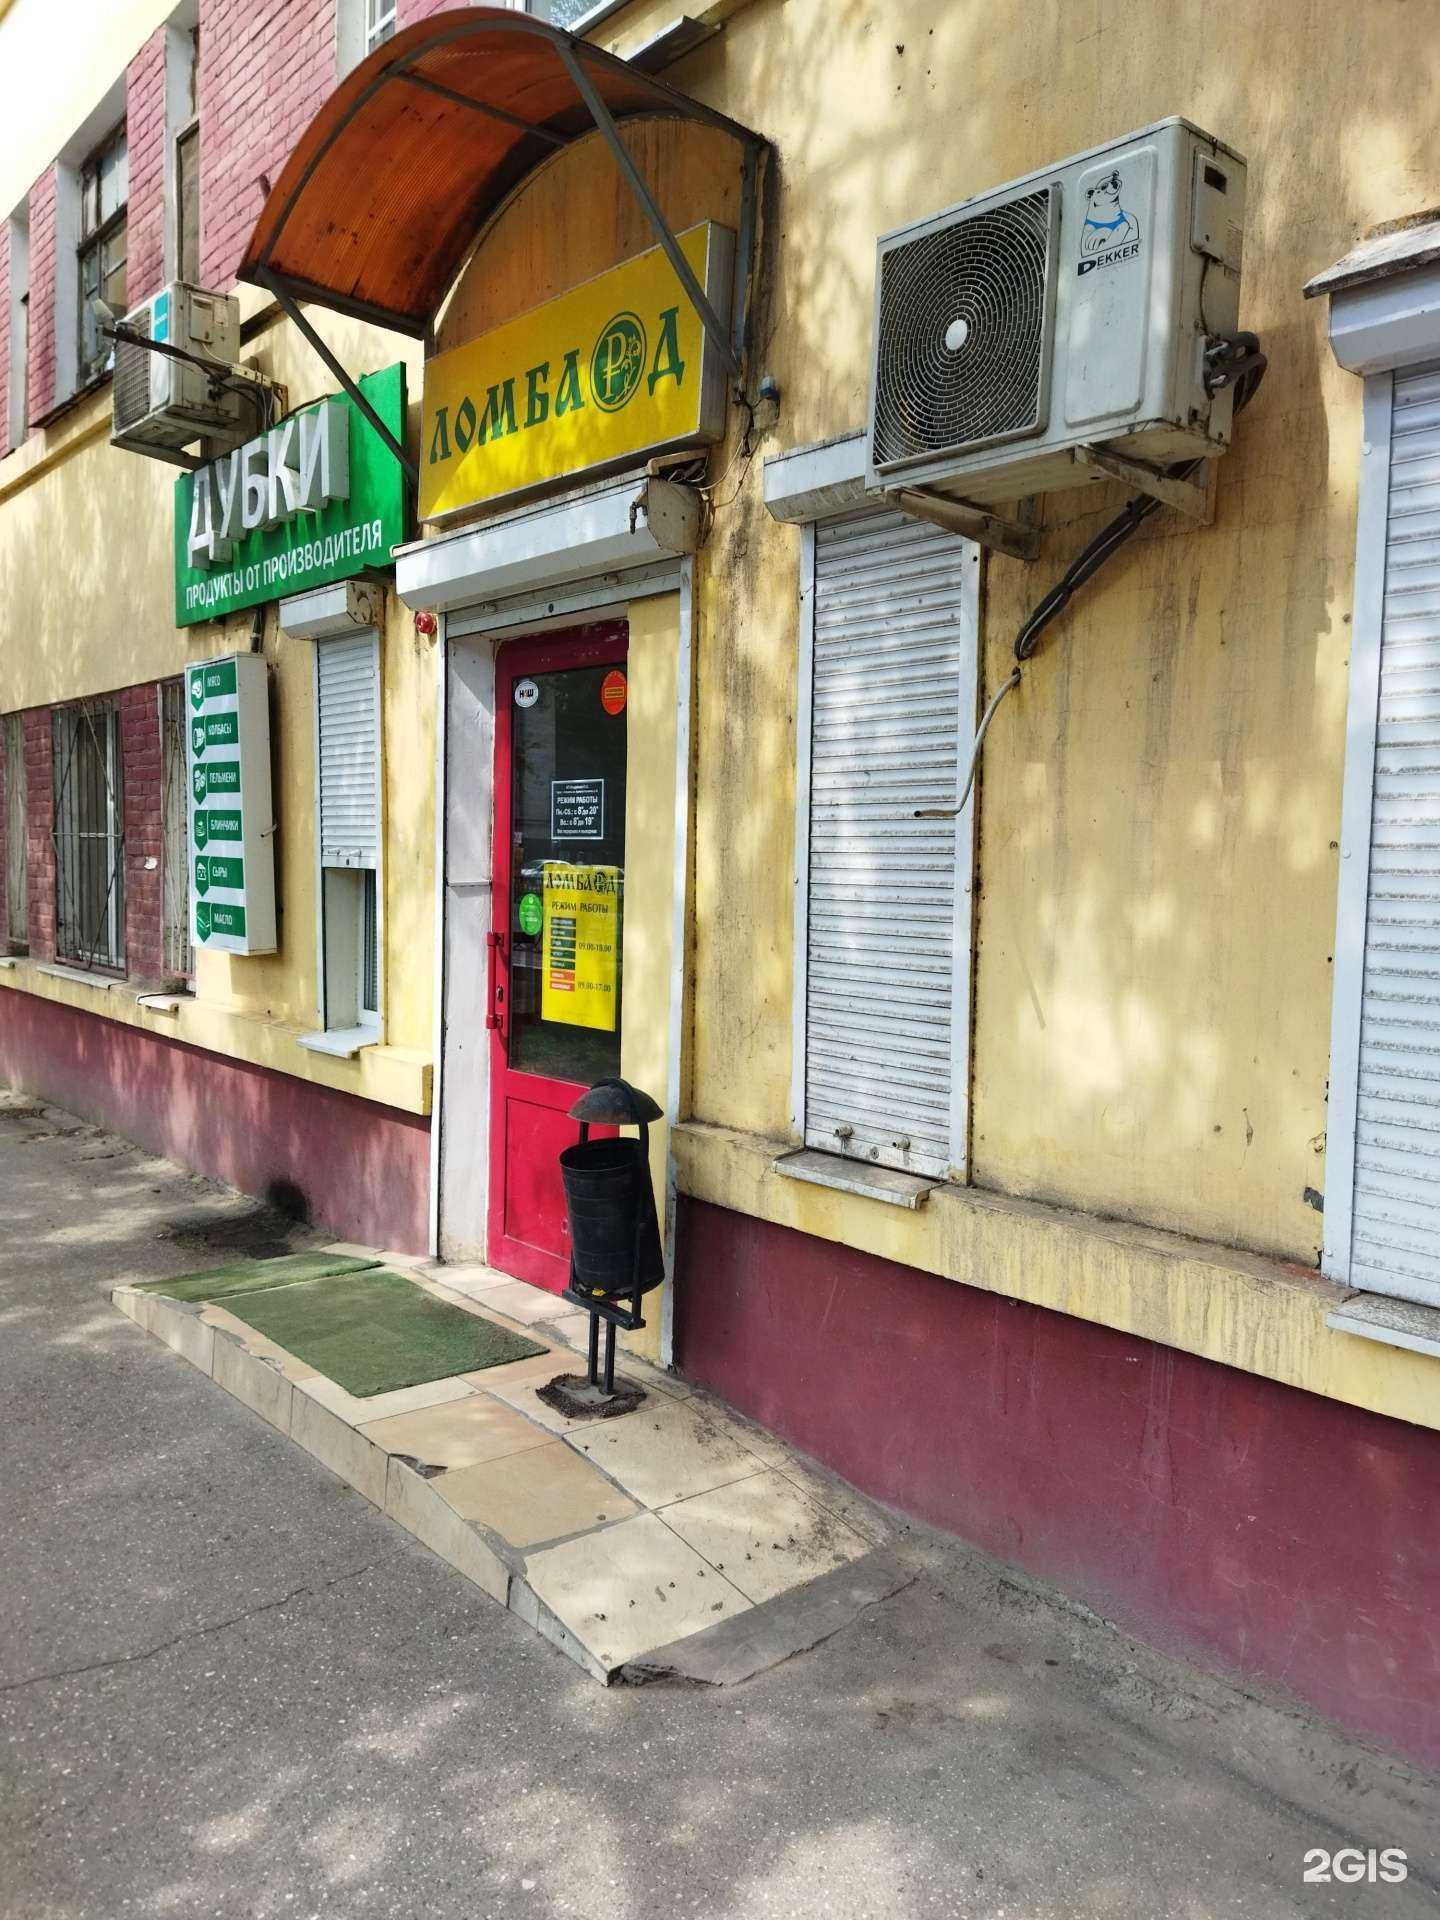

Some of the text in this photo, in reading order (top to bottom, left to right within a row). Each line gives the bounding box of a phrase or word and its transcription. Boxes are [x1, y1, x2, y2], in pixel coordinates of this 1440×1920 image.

[1077, 243, 1139, 276] DEKKER
[429, 306, 685, 465] ЛОМБАРД
[187, 398, 330, 568] ДУБКИ
[186, 519, 383, 610] ПРОДУКТЫ ОТ ПРОИЗВОДИТЕЛЯ
[207, 675, 221, 687] МЯСО
[208, 723, 232, 736] КОЛБАСЫ
[209, 771, 237, 784] ПЕЛЬМЕНИ
[576, 796, 598, 804] РАБОТЫ
[210, 819, 239, 831] БЛИНЧИКИ
[212, 866, 228, 878] СЫРЫ
[551, 901, 609, 914] РЕЖИМ РАБОТЫ
[214, 912, 233, 925] МАСЛО
